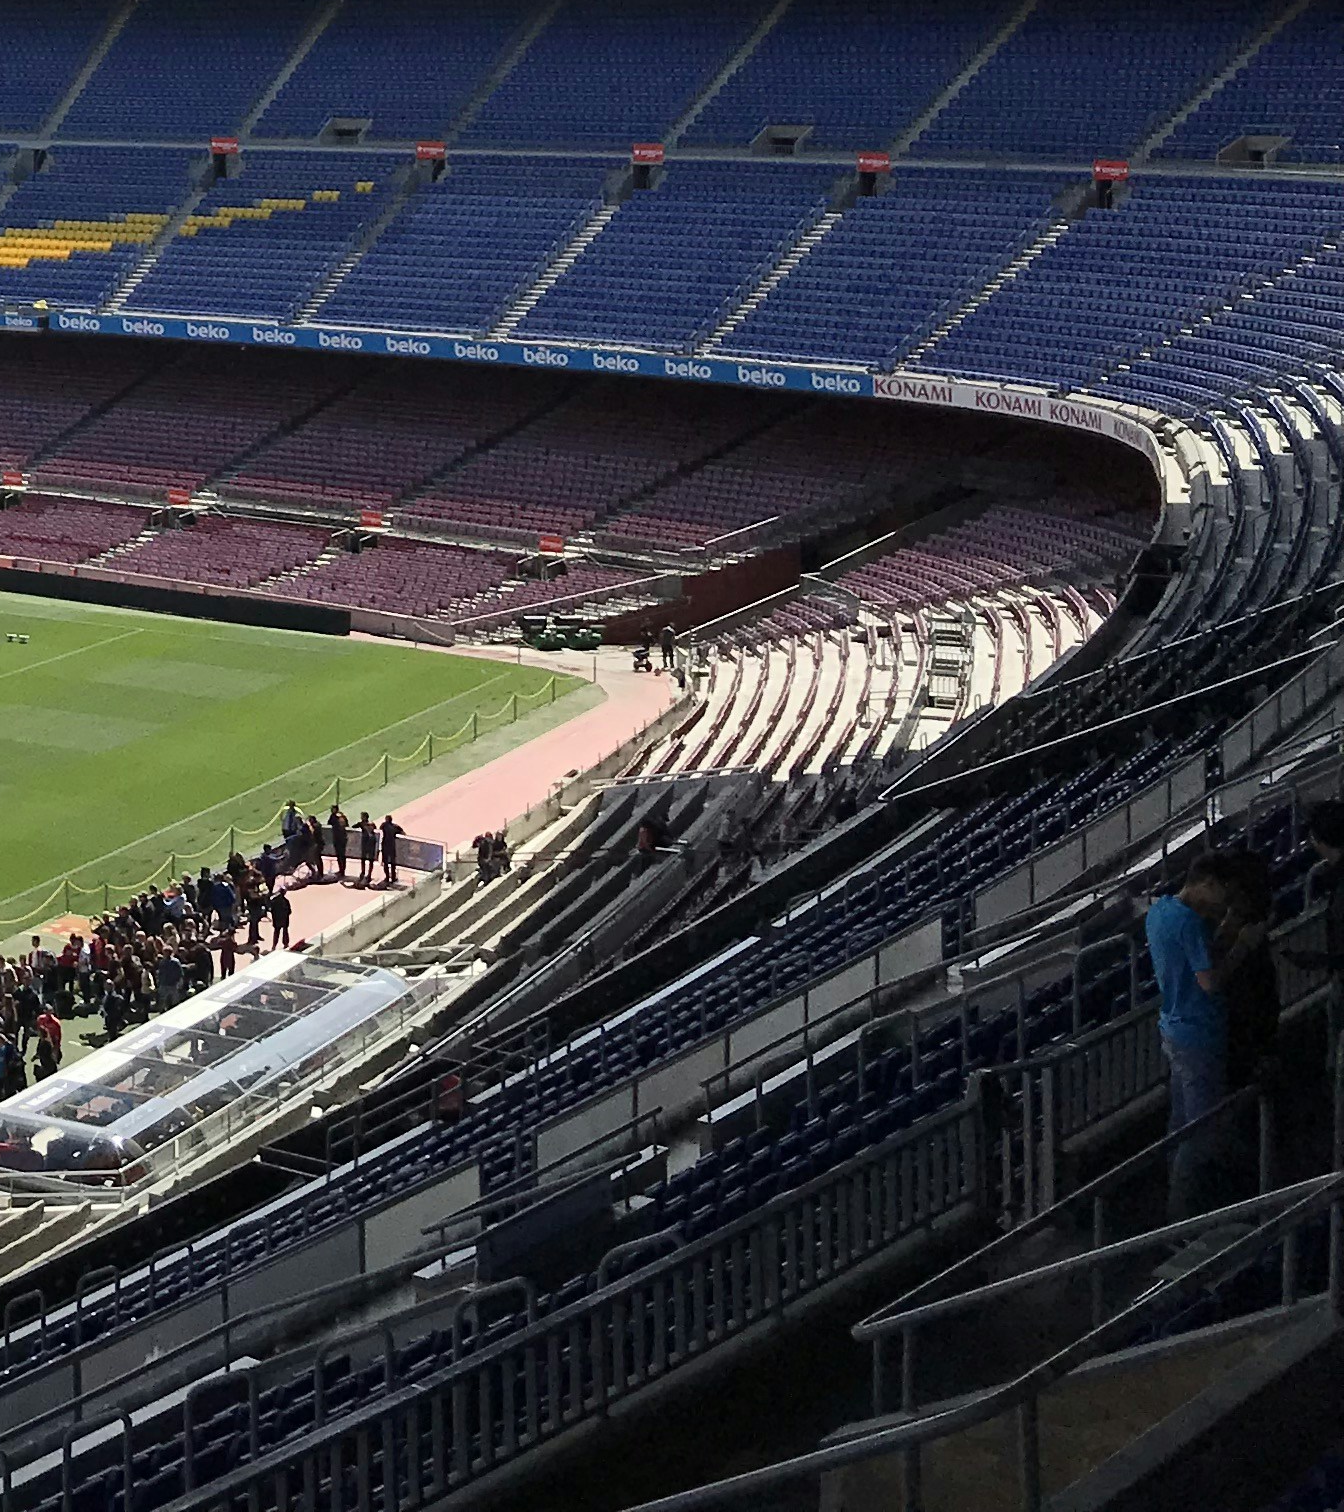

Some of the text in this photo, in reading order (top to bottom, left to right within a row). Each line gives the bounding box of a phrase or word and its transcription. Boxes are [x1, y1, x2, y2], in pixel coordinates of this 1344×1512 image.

[5, 316, 32, 327] beko
[58, 315, 100, 331] beko
[122, 319, 164, 335] beko
[187, 323, 229, 339] beko
[252, 327, 295, 343] beko
[319, 332, 362, 350] beko
[386, 337, 430, 355] beko
[454, 343, 499, 361] beko
[523, 348, 568, 366] beko
[593, 353, 639, 371] beko
[665, 359, 711, 378] beko
[737, 365, 786, 386] beko
[812, 372, 860, 393] beko
[874, 379, 953, 403] KONAMI
[976, 390, 1042, 417] KONAMI
[1050, 403, 1102, 431] KONAMI
